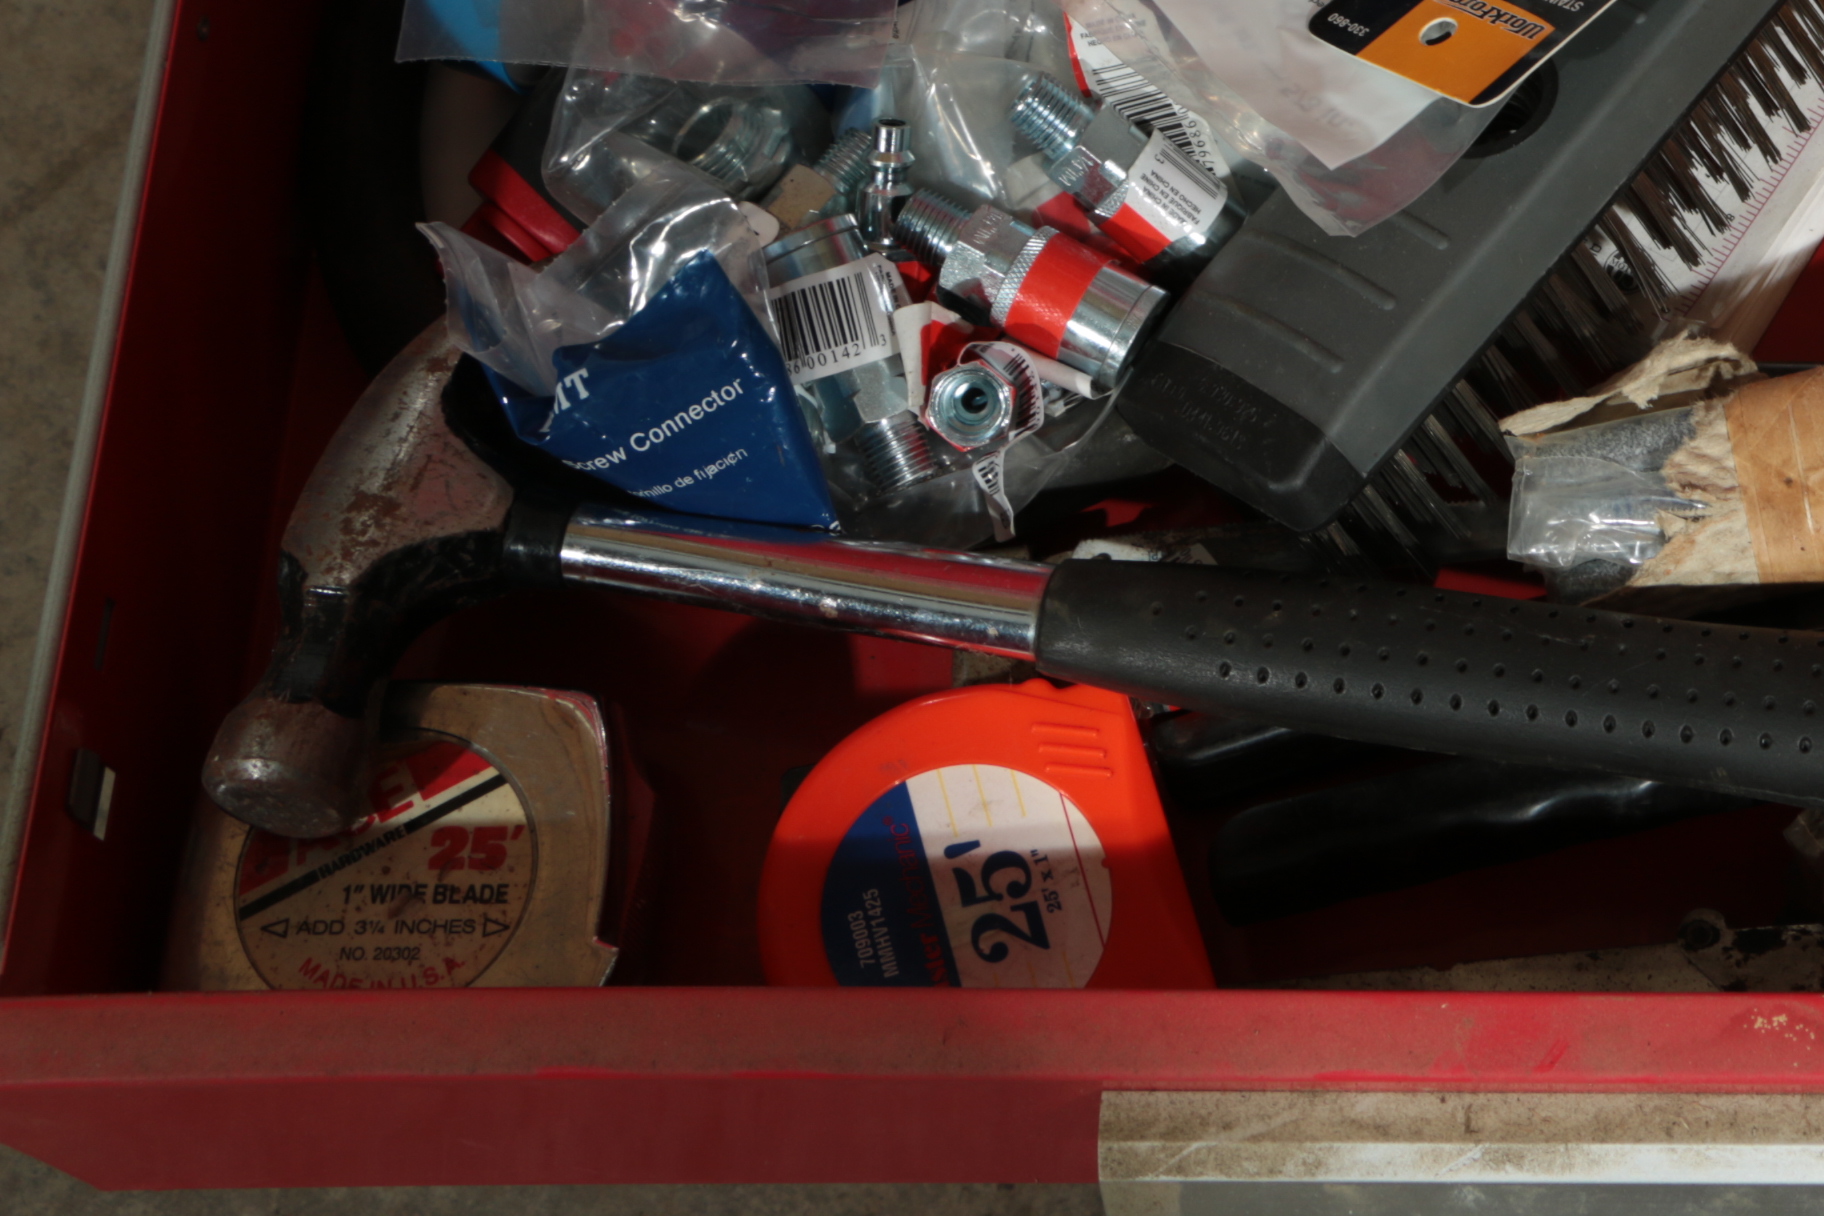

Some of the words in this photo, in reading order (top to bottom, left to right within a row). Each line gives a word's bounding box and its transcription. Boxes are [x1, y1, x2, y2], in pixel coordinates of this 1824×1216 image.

[1326, 10, 1370, 37] 330-860
[1138, 172, 1162, 193] CHINE
[1148, 168, 1175, 191] CHINA
[1159, 190, 1169, 199] EN
[1172, 188, 1183, 198] EN
[1182, 197, 1202, 214] HECHO
[805, 342, 862, 370] 00142
[878, 333, 887, 347] 3
[627, 377, 745, 455] Connector
[672, 471, 694, 490] de
[316, 826, 407, 880] HARDWARE
[427, 824, 525, 870] 25'
[370, 883, 426, 904] WIDE
[432, 883, 509, 904] BLADE
[970, 838, 1052, 966] 25'
[295, 919, 344, 934] ADD
[393, 919, 476, 933] INCHES
[863, 888, 899, 977] MMHV1425
[847, 910, 875, 967] 709003
[339, 947, 365, 960] NO.
[372, 946, 421, 960] 20302
